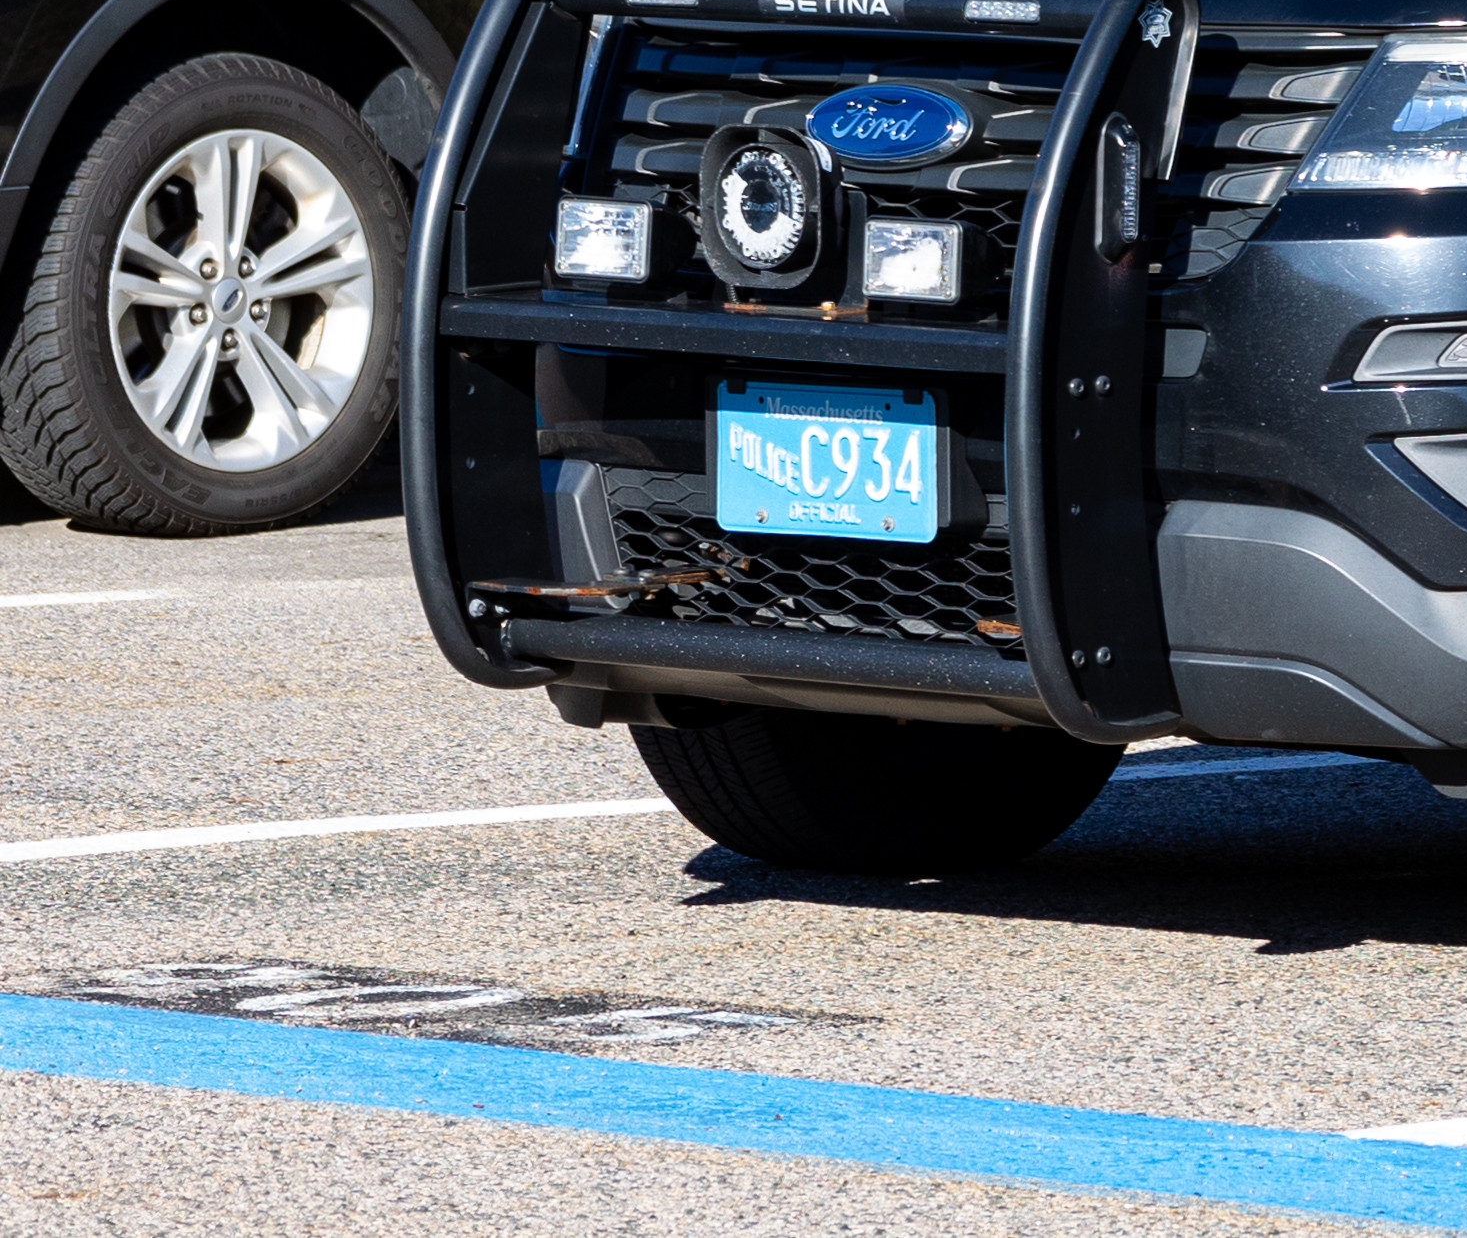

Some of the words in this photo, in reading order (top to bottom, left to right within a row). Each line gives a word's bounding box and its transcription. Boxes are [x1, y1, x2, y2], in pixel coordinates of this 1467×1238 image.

[831, 95, 925, 142] Ford
[765, 396, 884, 425] Massachusetts
[729, 421, 801, 495] POLICE
[800, 424, 922, 505] C934
[788, 501, 862, 526] OFFICIAL
